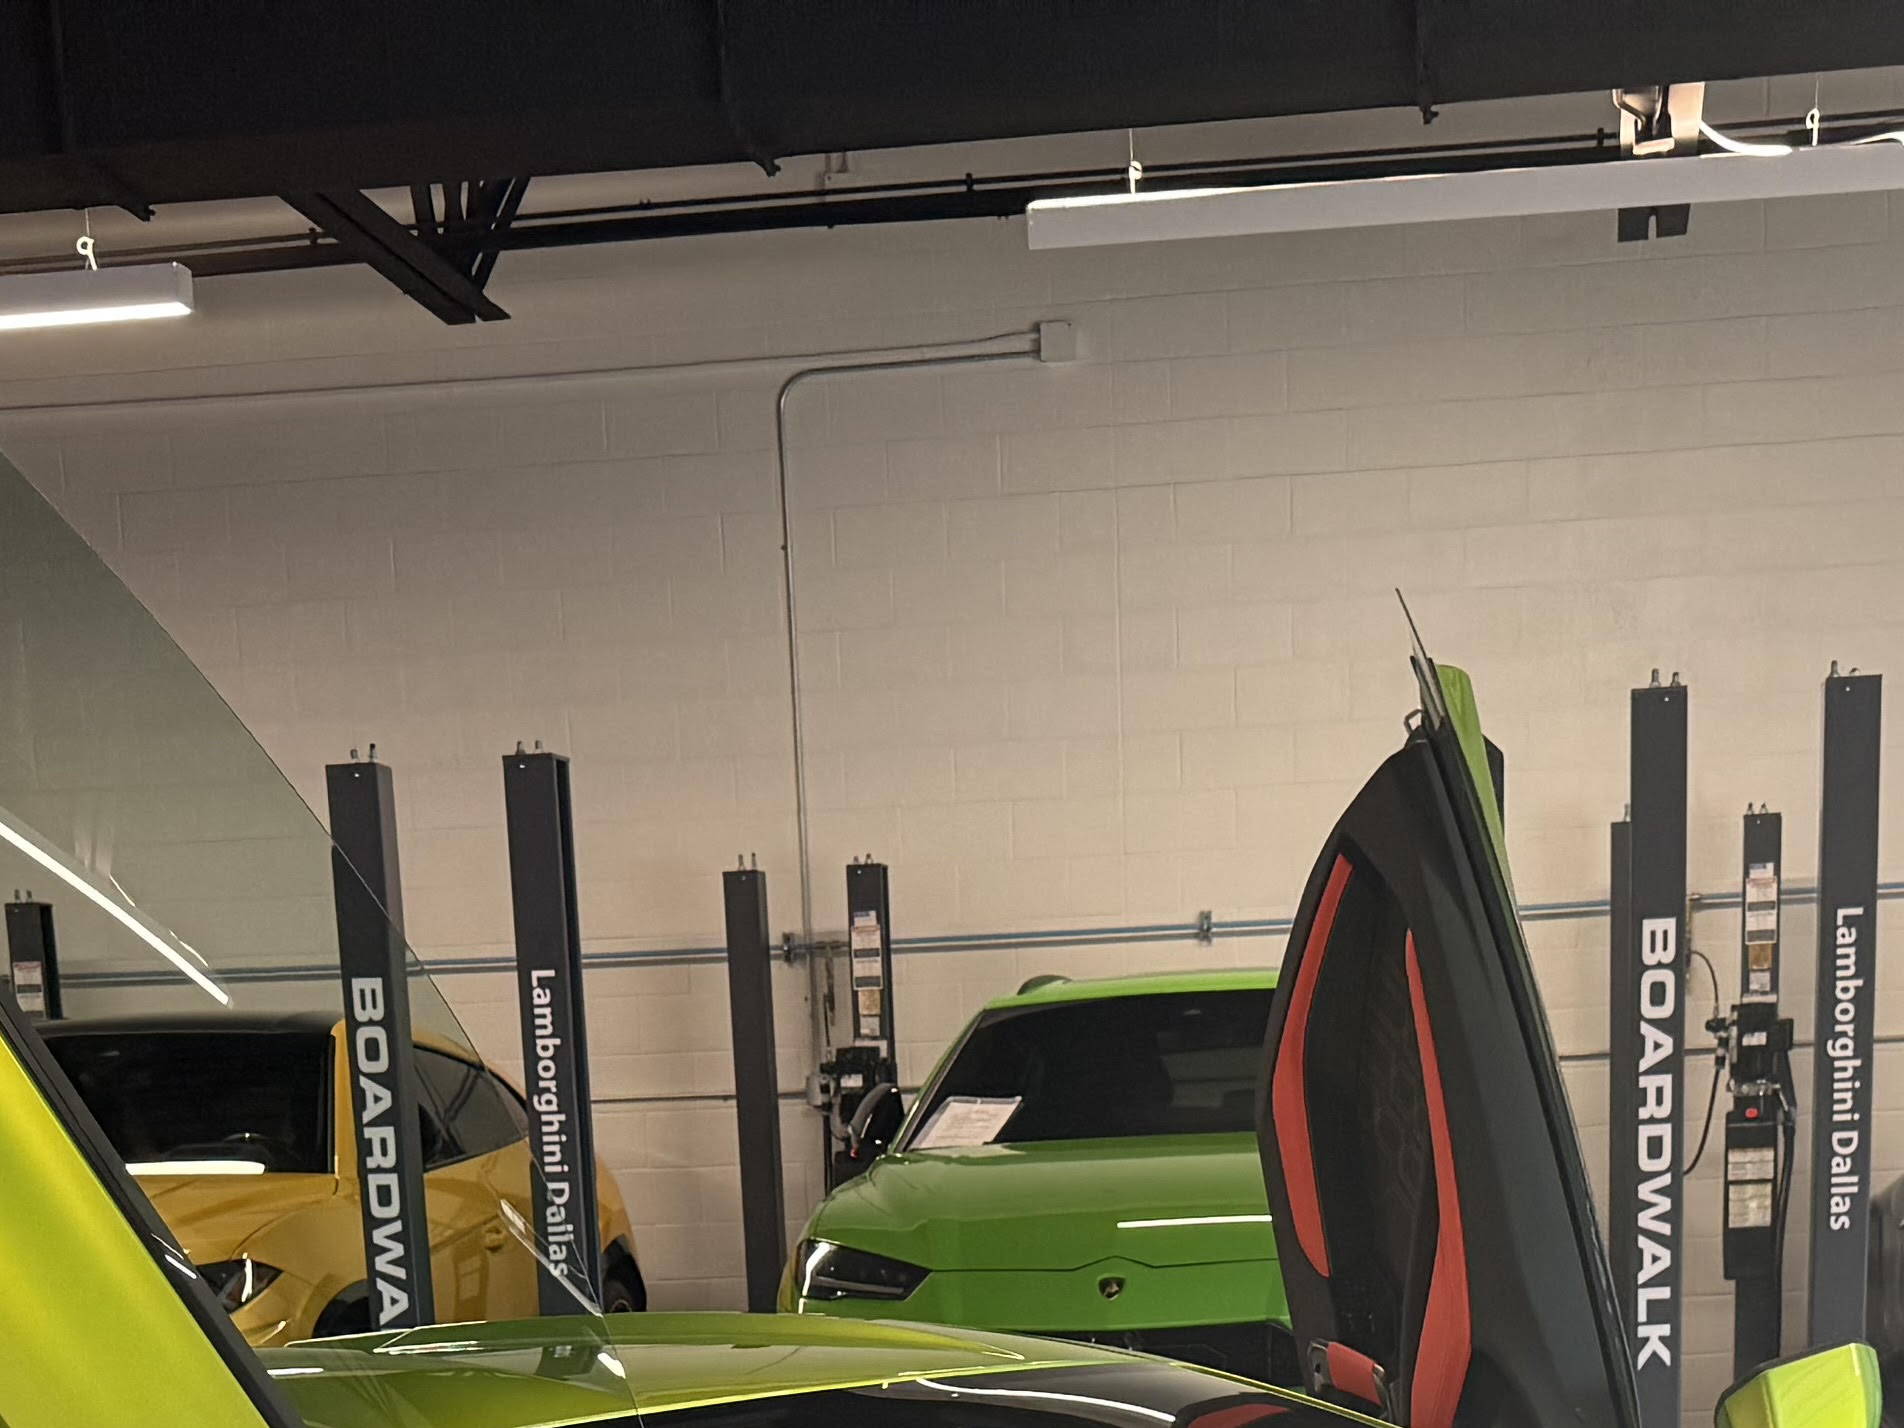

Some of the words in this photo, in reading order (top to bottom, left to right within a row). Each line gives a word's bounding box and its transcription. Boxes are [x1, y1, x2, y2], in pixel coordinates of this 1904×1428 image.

[531, 969, 570, 1174] Lamborghini
[1826, 907, 1864, 1122] Lamborghini
[351, 977, 410, 1326] BOARDWA
[545, 1181, 575, 1277] Dallas
[1636, 917, 1677, 1371] BOARDWALK
[1829, 1130, 1859, 1231] Dallas
